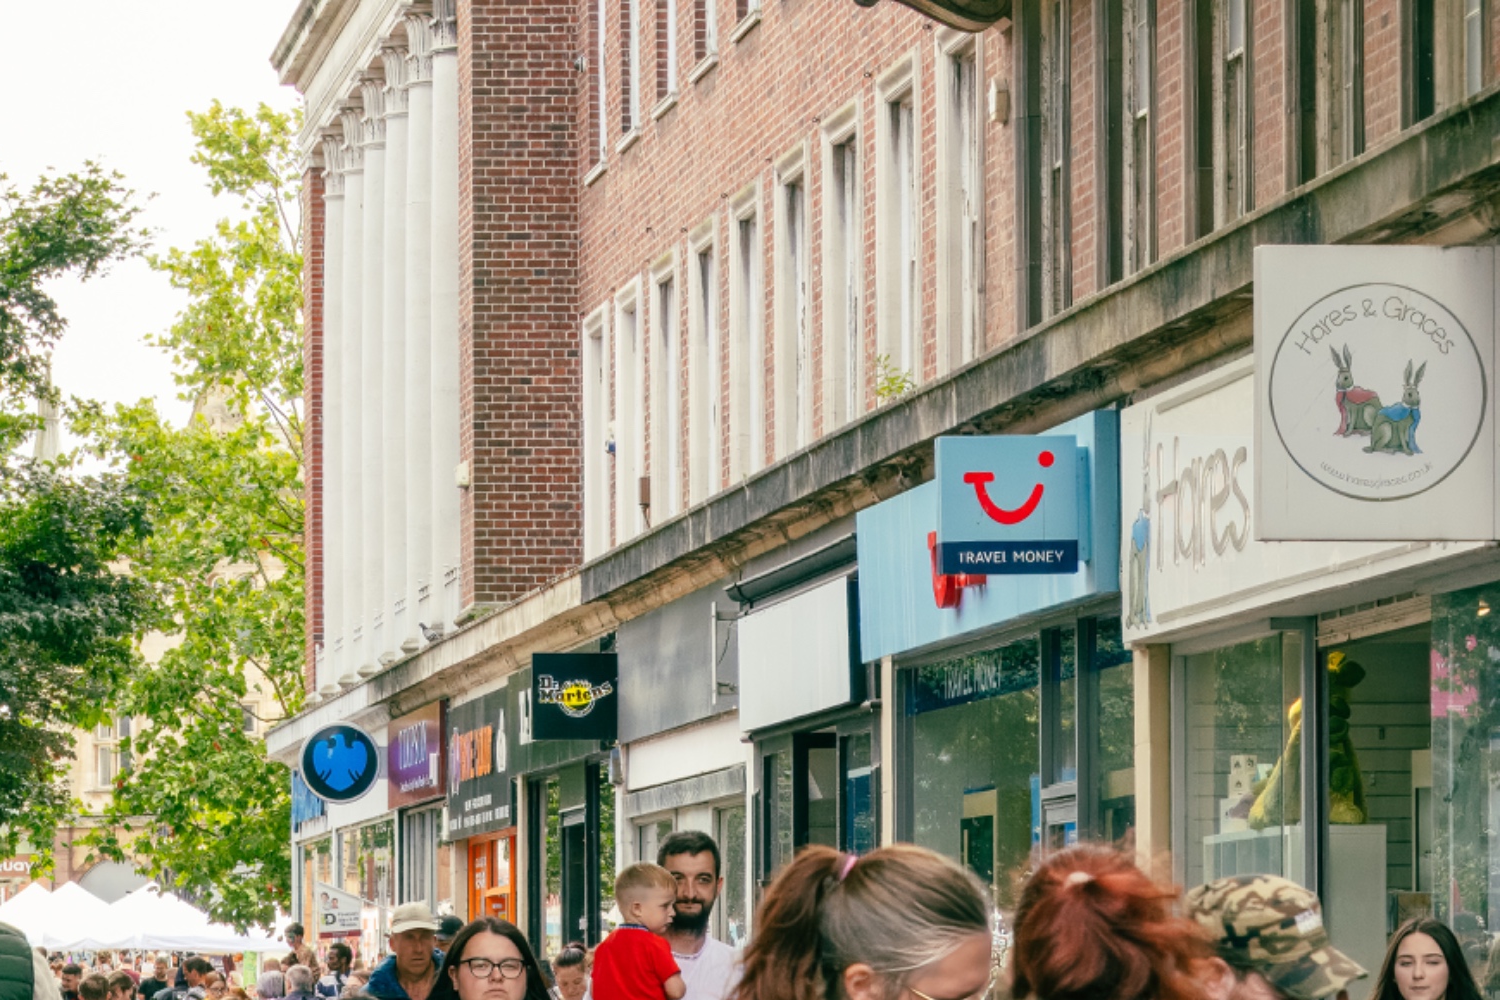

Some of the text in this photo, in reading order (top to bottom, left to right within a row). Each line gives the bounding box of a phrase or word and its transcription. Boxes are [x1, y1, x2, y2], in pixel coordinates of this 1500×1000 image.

[1294, 295, 1456, 356] Hares & Graces
[1156, 435, 1251, 574] Hares
[958, 549, 1064, 564] TRAVEL MONEY
[538, 681, 613, 703] Martens
